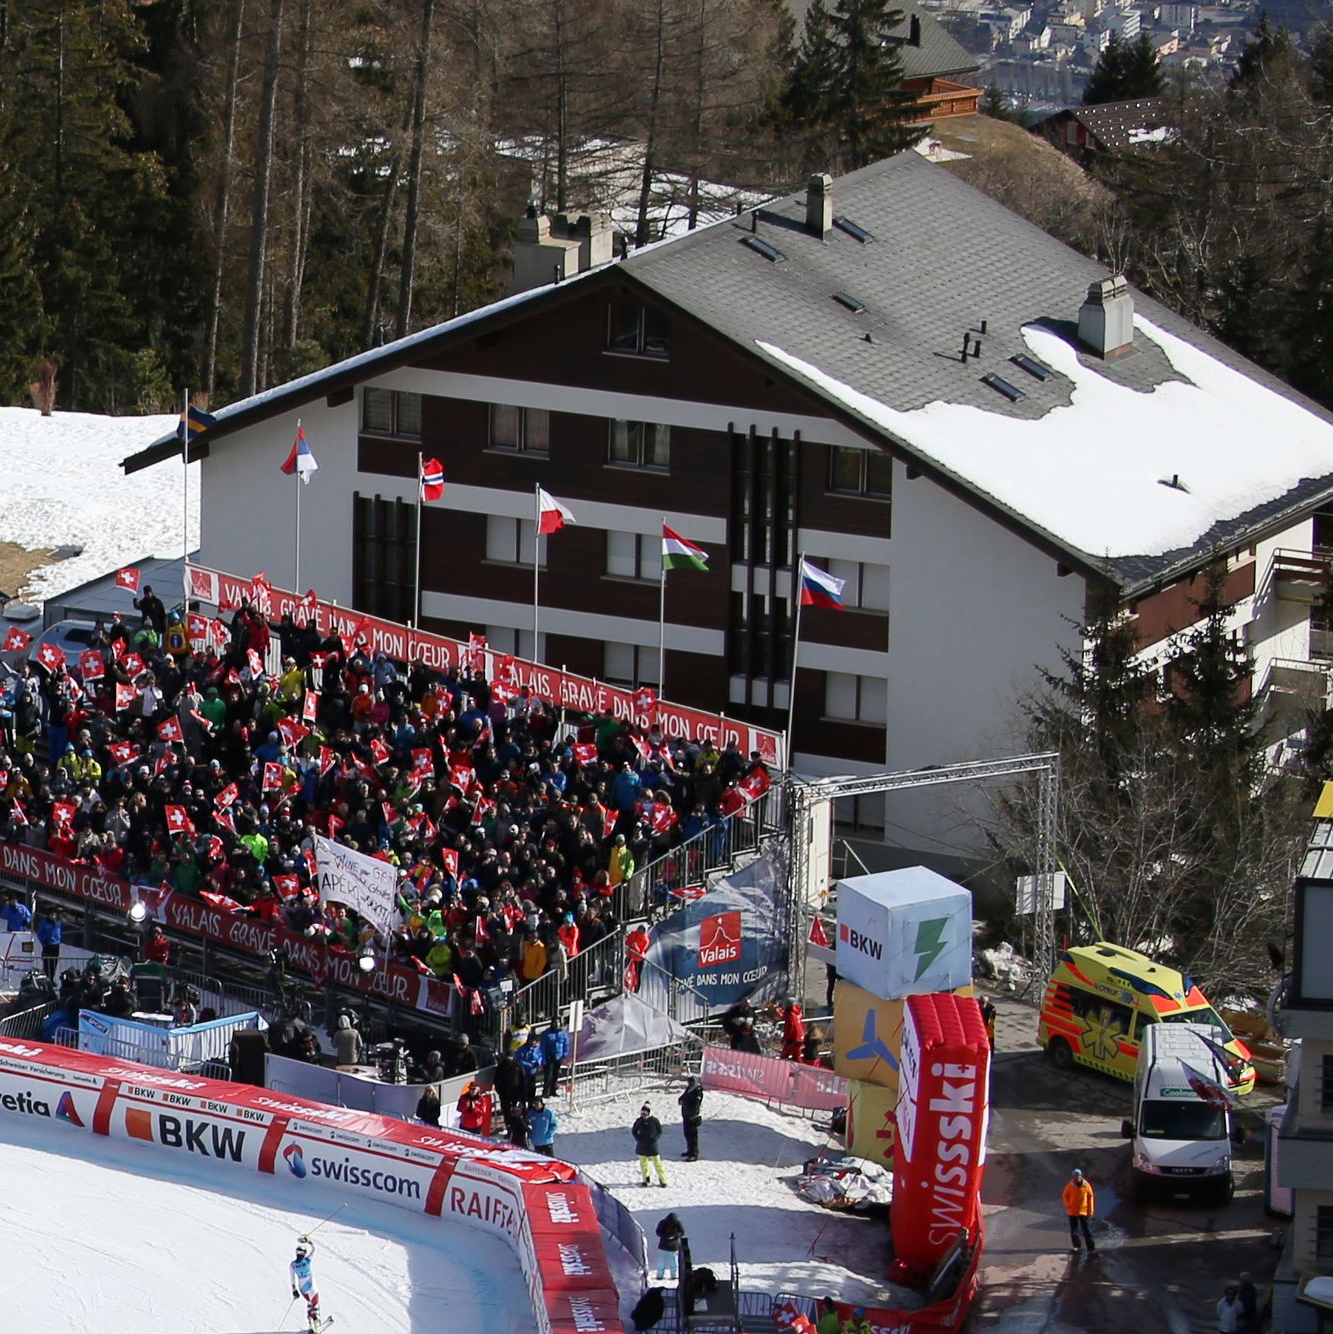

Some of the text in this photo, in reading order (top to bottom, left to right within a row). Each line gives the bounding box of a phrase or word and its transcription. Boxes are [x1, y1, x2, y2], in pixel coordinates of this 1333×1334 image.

[372, 628, 404, 657] MON
[656, 712, 690, 742] MON
[3, 845, 40, 879] DANS
[45, 862, 76, 892] MON
[700, 944, 737, 966] Valais
[851, 932, 883, 960] BKW
[697, 973, 719, 988] DANS
[720, 971, 741, 985] MON
[134, 1087, 155, 1099] BKW
[169, 1094, 191, 1106] BKW
[207, 1101, 228, 1114] BKW
[244, 1109, 265, 1122] BKW
[159, 1114, 245, 1162] BKW
[311, 1156, 421, 1200] swisscom
